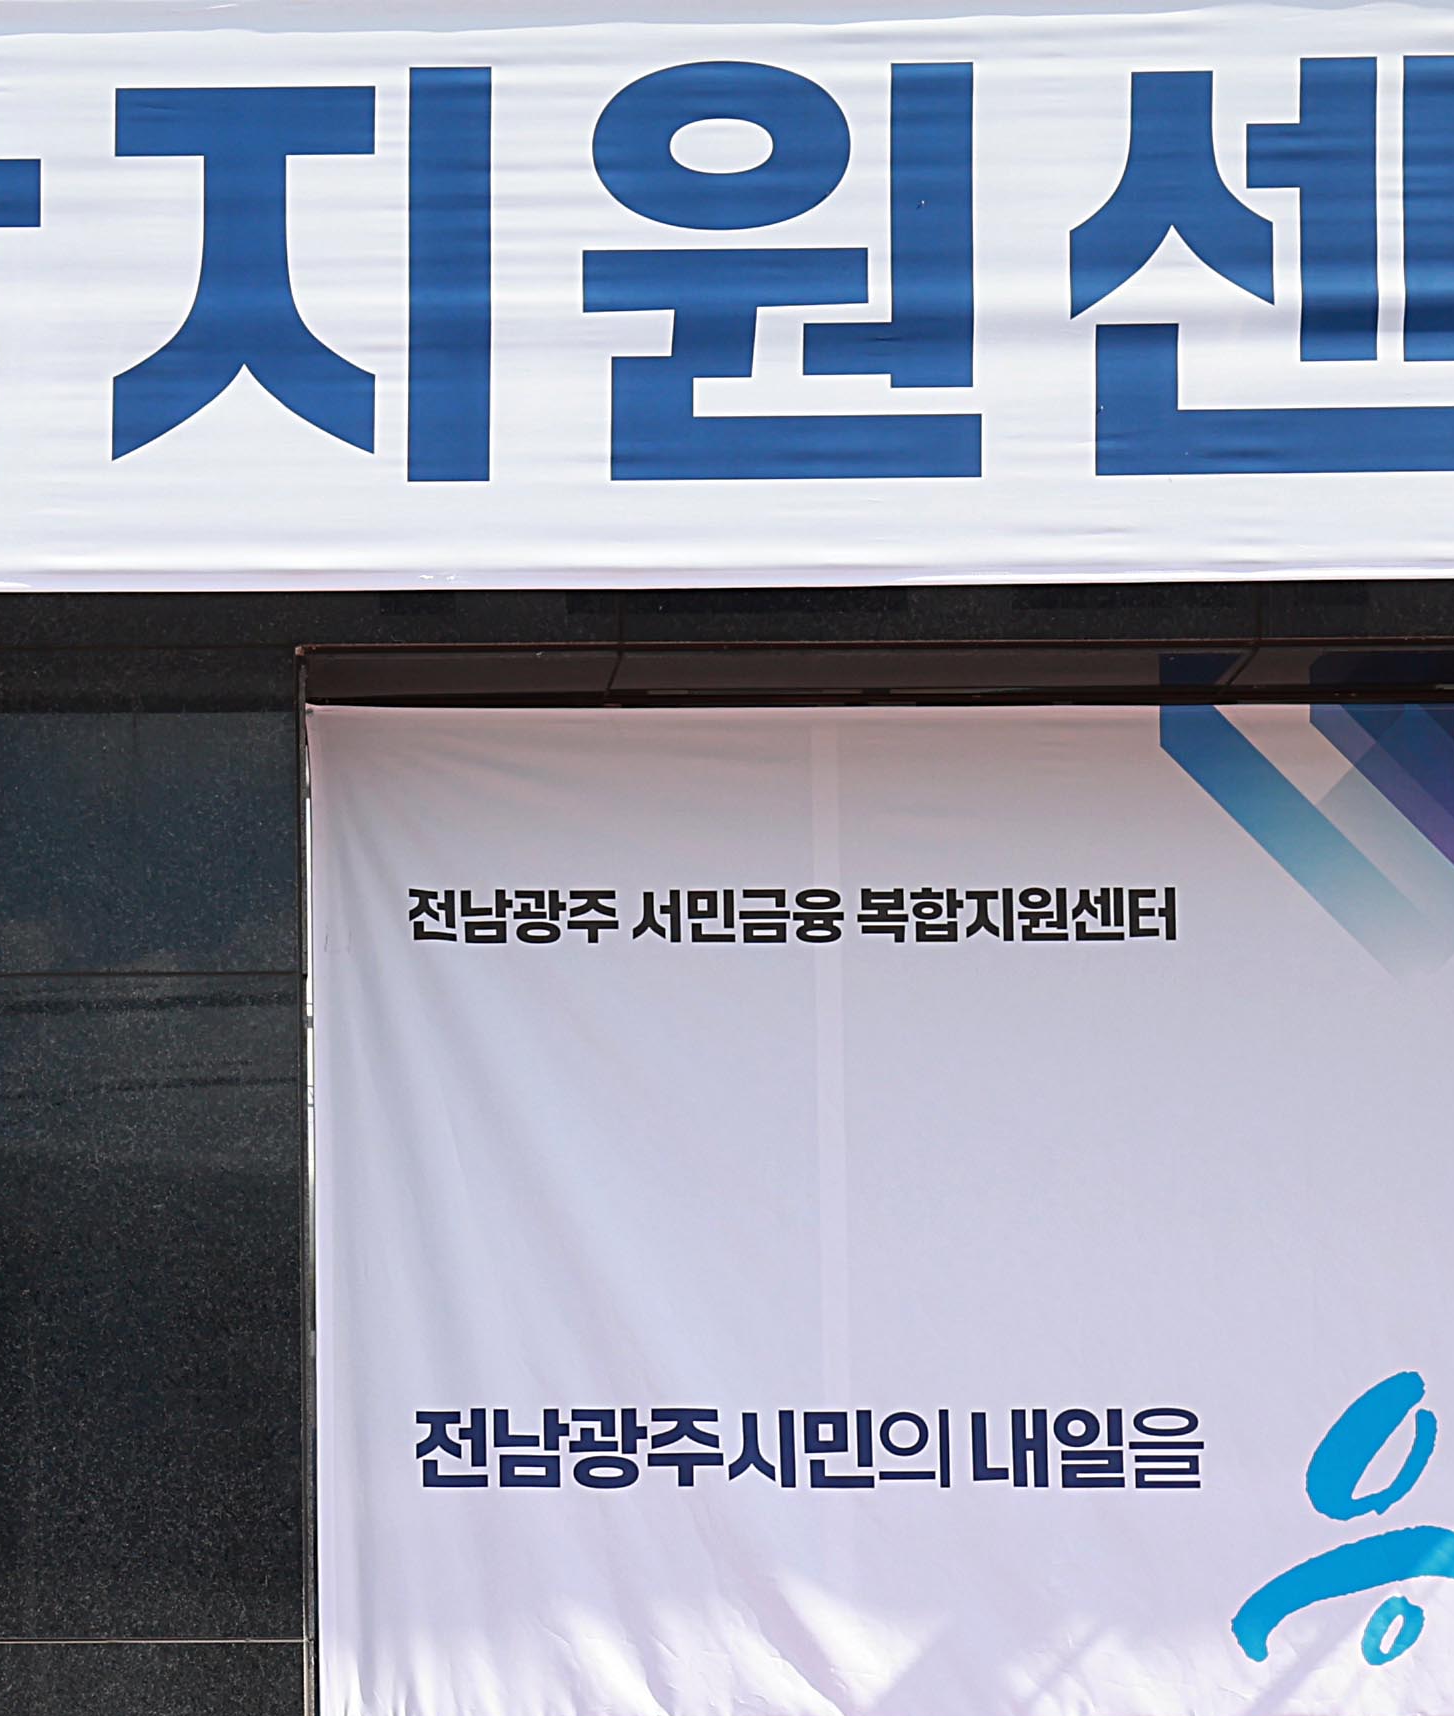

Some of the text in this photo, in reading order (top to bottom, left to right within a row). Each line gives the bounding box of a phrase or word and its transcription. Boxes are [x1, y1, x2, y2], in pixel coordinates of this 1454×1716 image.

[407, 886, 1178, 944] 전남광주 서민금융 복합지원센터
[415, 1407, 951, 1489] 전남광주시민의
[971, 1407, 1205, 1489] 내일을
